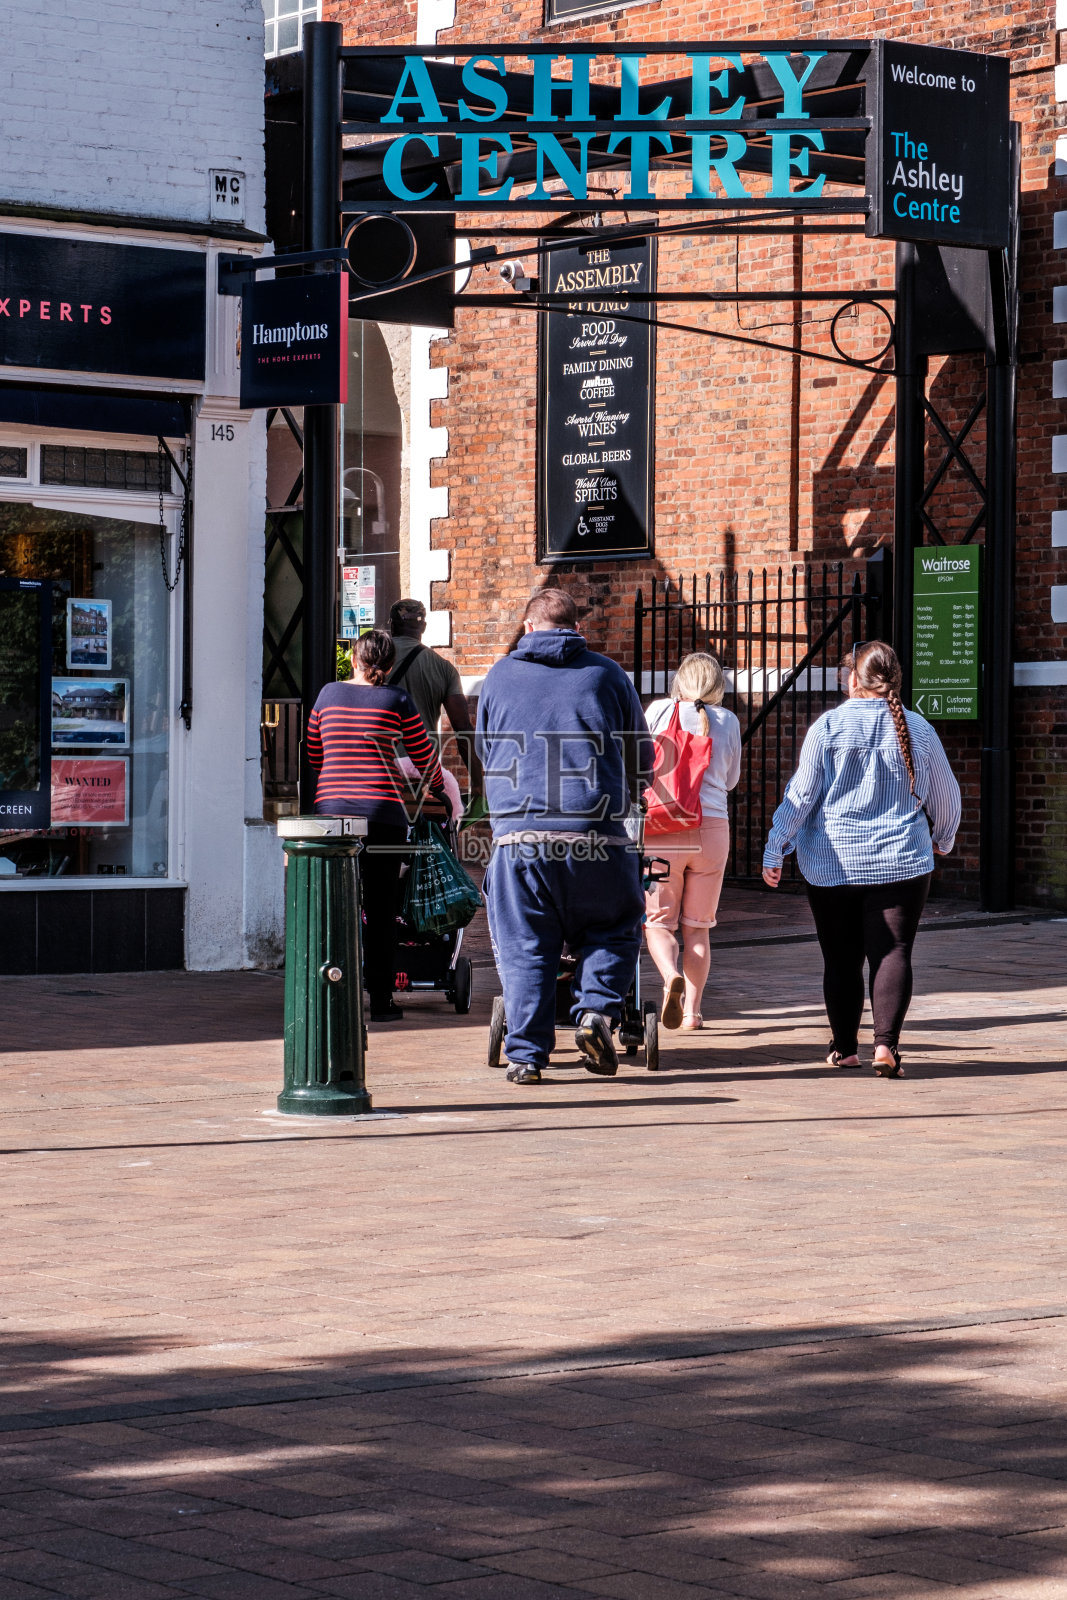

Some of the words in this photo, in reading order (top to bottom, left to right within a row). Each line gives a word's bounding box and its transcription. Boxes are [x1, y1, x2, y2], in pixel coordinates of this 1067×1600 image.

[890, 63, 957, 90] Welcome
[961, 75, 976, 93] to
[379, 50, 828, 124] ASHLEY
[890, 131, 929, 161] The
[381, 128, 827, 201] CENTRE
[891, 160, 963, 201] Ashley
[892, 191, 961, 224] Centre
[586, 248, 611, 264] THE
[554, 262, 643, 293] ASSEMBLY
[252, 321, 328, 348] Hamptons
[581, 320, 616, 337] FOOD
[568, 337, 596, 349] Served
[597, 334, 608, 346] all
[609, 333, 628, 348] Day
[257, 356, 270, 364] THE
[272, 355, 290, 363] HOME
[292, 353, 321, 361] EXPERTS
[562, 360, 598, 375] FAMILY
[599, 356, 634, 371] DINING
[579, 385, 616, 400] COFFEE
[564, 413, 593, 426] Award
[594, 410, 631, 424] Winning
[211, 424, 235, 441] 145
[577, 420, 617, 437] WINES
[562, 452, 600, 466] GLOBAL
[601, 449, 632, 463] BEERS
[574, 477, 600, 489] World
[599, 476, 617, 487] Class
[574, 487, 618, 503] SPIRITS
[588, 515, 616, 523] ASSISTANCE
[921, 556, 971, 572] Waitrose
[937, 575, 954, 583] EPSOM
[916, 632, 935, 640] Thursday
[915, 641, 929, 649] Friday
[915, 650, 934, 658] Saturday
[946, 695, 973, 704] Customer
[946, 705, 972, 713] entrance
[64, 776, 112, 787] WANTED
[345, 821, 351, 832] 1
